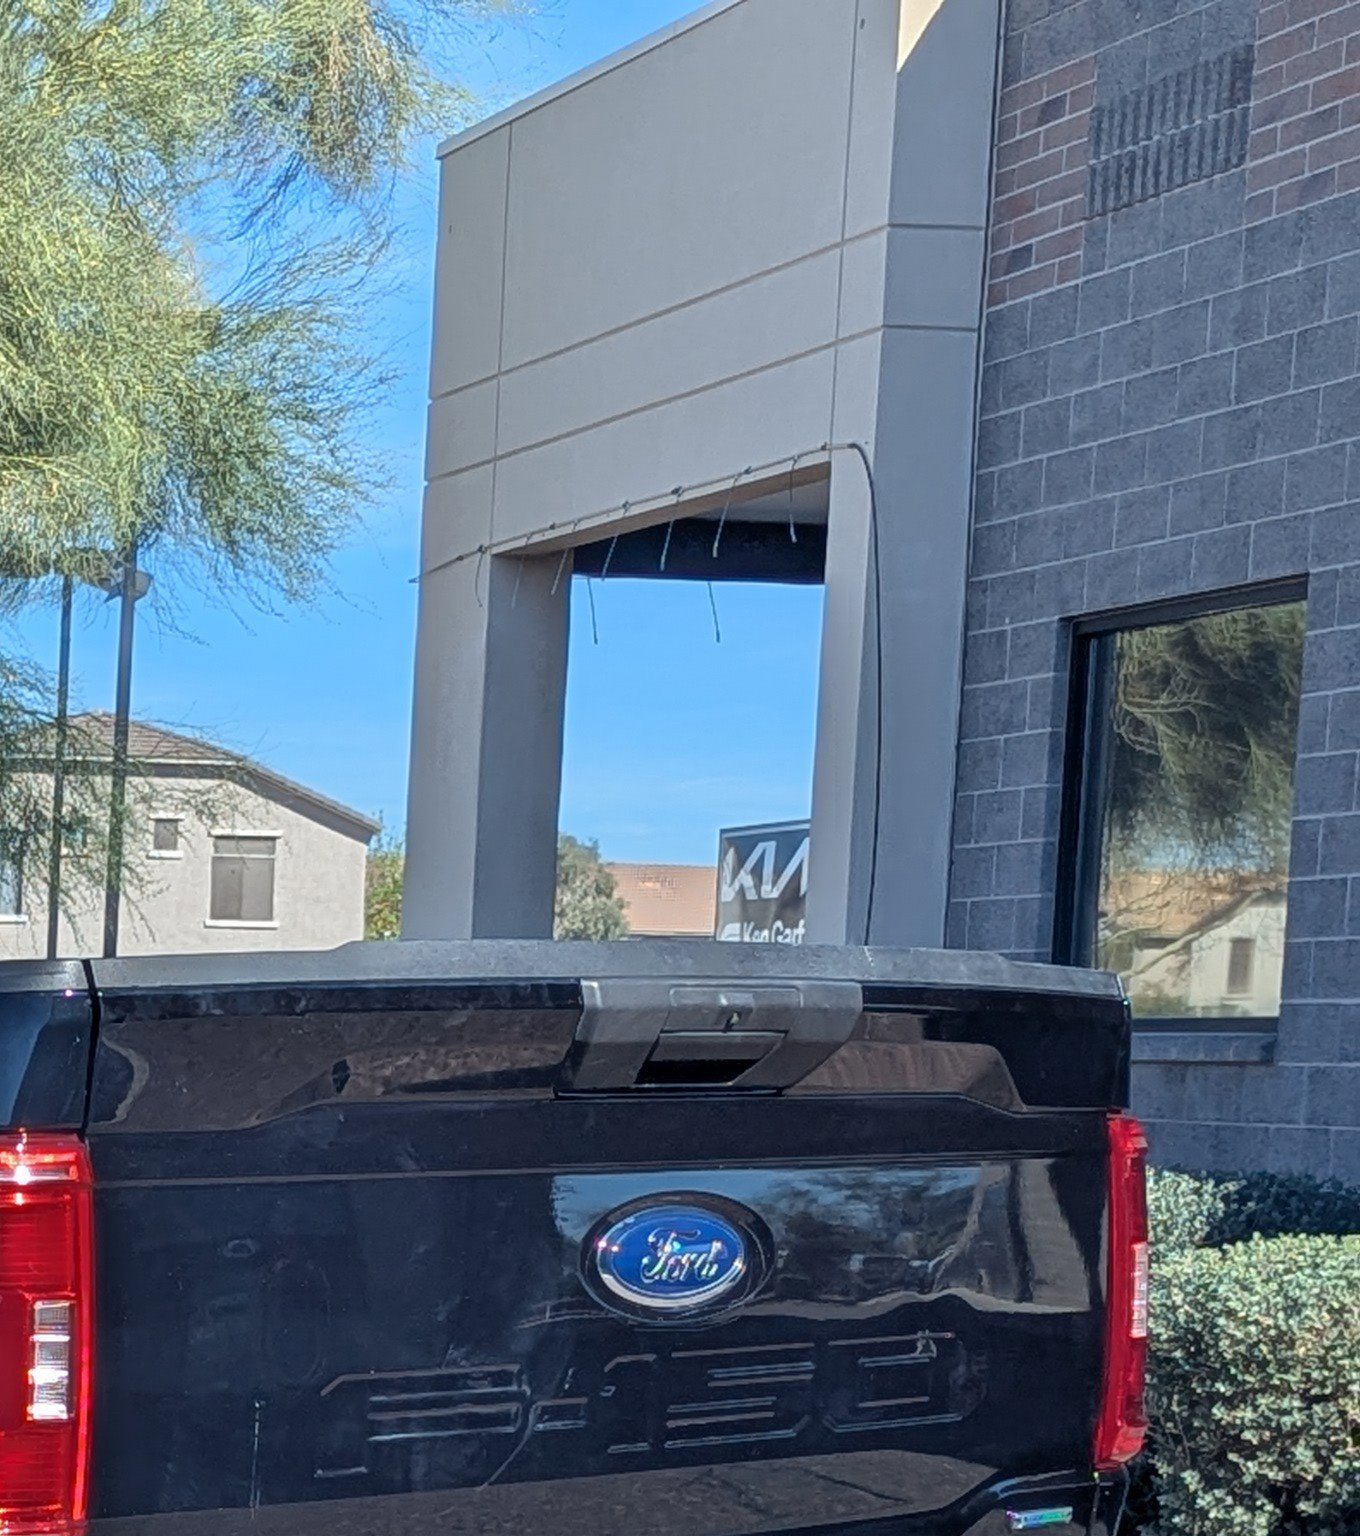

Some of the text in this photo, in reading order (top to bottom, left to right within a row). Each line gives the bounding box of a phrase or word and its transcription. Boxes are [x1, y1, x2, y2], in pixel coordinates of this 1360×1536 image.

[742, 919, 806, 946] Ken Garf
[640, 1228, 726, 1284] Ford
